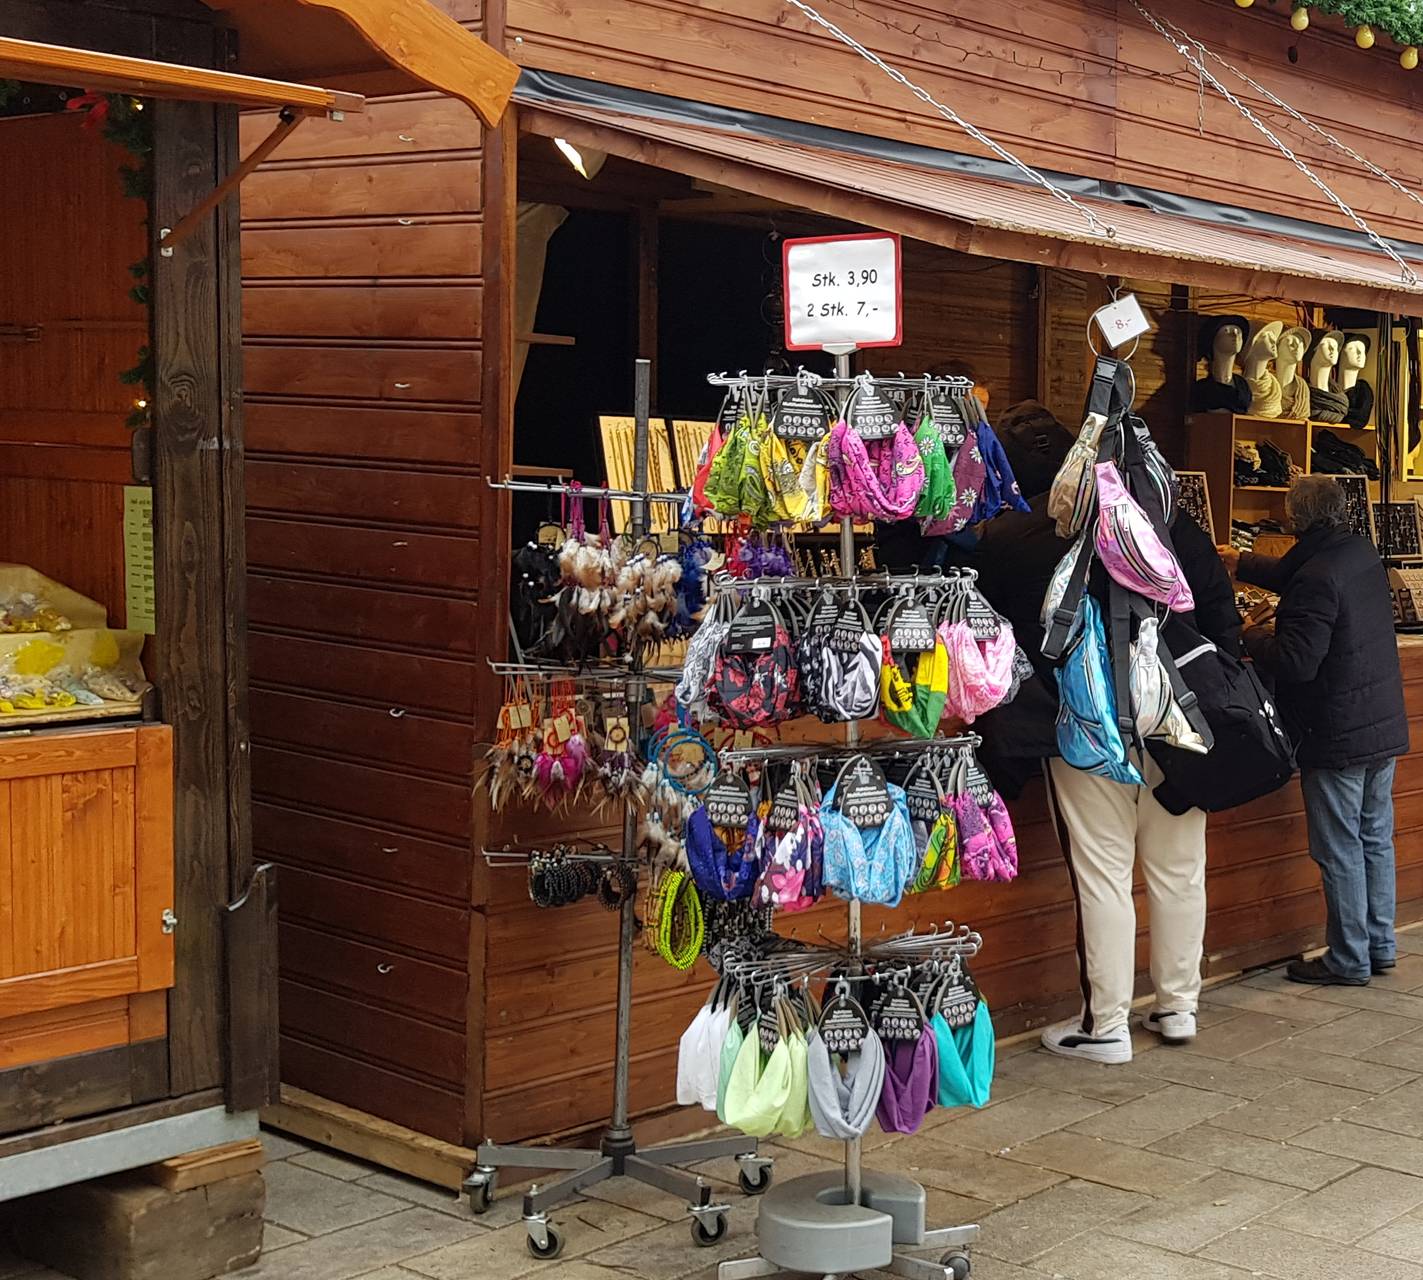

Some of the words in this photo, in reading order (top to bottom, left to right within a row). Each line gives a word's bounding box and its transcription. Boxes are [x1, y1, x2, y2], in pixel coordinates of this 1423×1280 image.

[811, 272, 840, 288] Stk.
[847, 268, 879, 288] 3,90
[807, 303, 815, 318] 2
[820, 302, 848, 317] Stk.
[856, 301, 879, 317] 7,-
